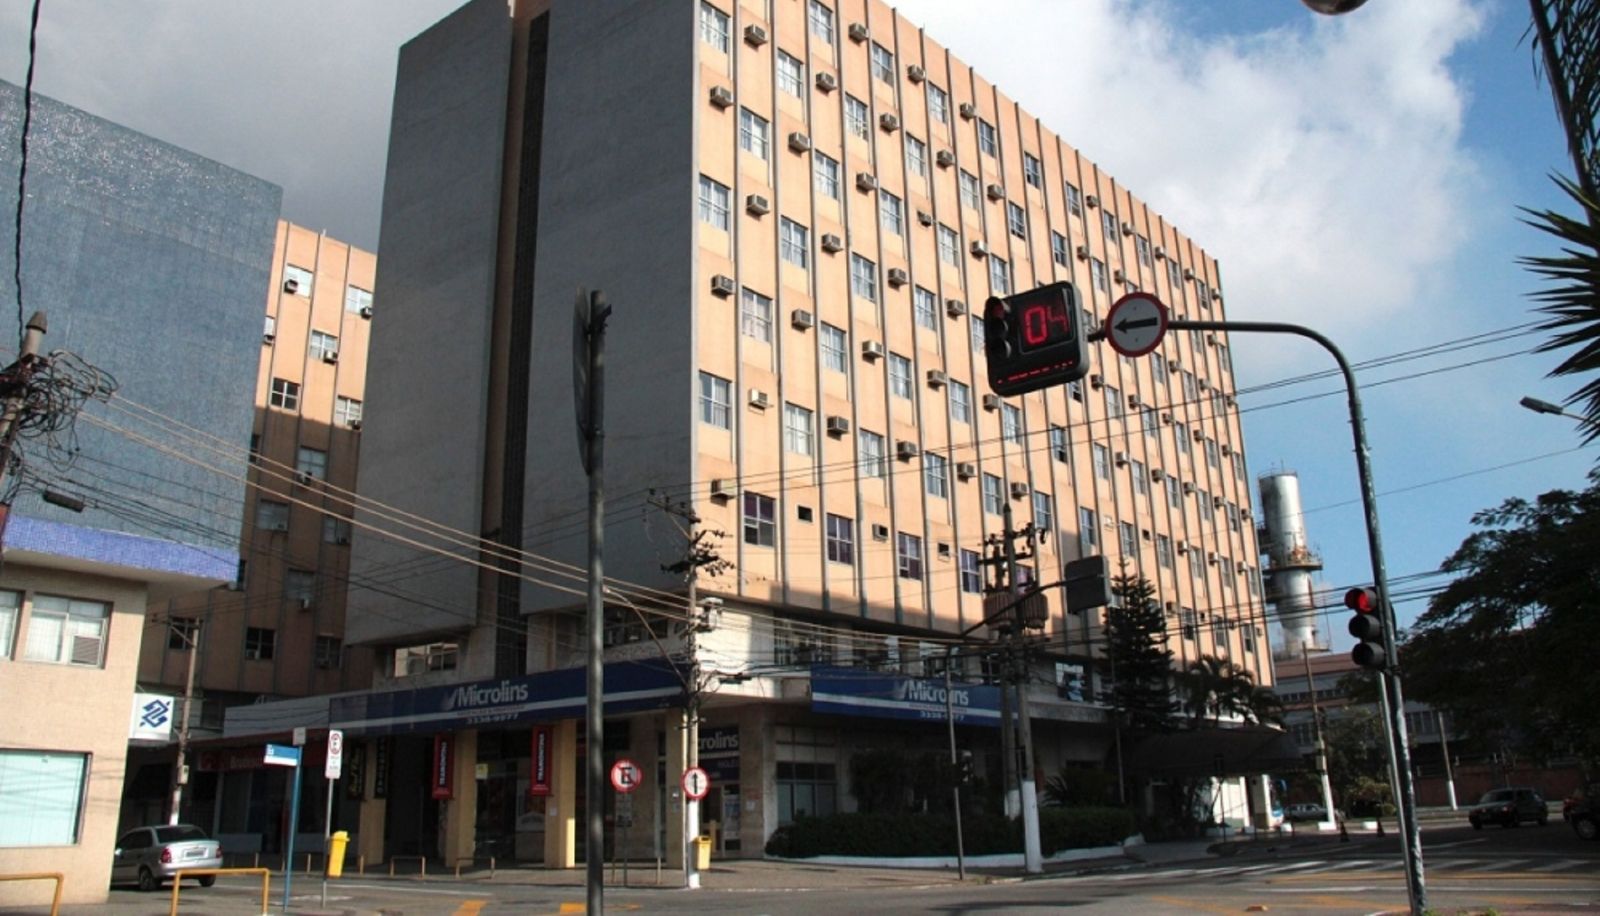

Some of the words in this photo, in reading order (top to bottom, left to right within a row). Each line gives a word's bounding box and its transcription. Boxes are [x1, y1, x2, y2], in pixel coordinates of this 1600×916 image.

[1024, 303, 1069, 345] 04
[458, 679, 529, 707] Microlins
[908, 679, 968, 705] Microns
[698, 731, 738, 750] rolins
